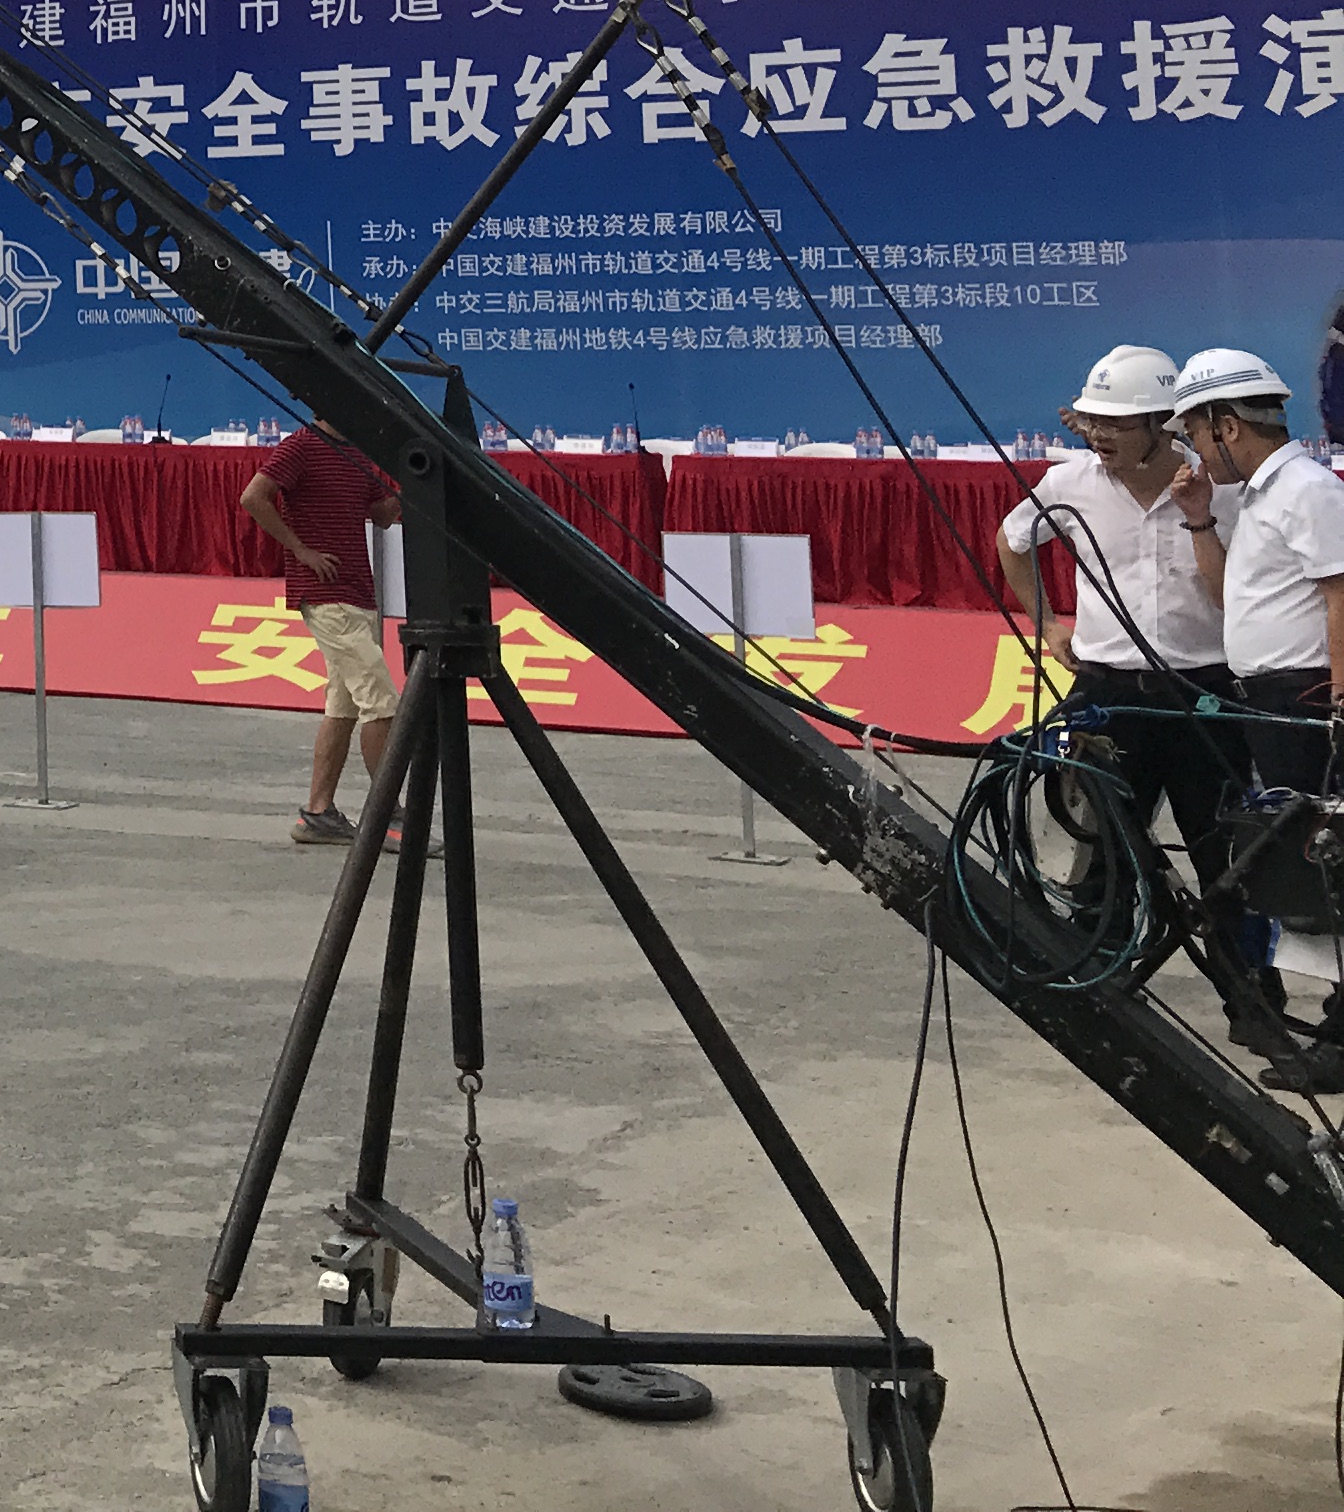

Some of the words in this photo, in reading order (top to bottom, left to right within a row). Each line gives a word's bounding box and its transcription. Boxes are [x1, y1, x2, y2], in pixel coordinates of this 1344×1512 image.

[76, 308, 110, 325] CHINA
[113, 306, 198, 325] COMMUNICATIO
[1156, 374, 1176, 387] VIP
[1190, 368, 1215, 382] VIP
